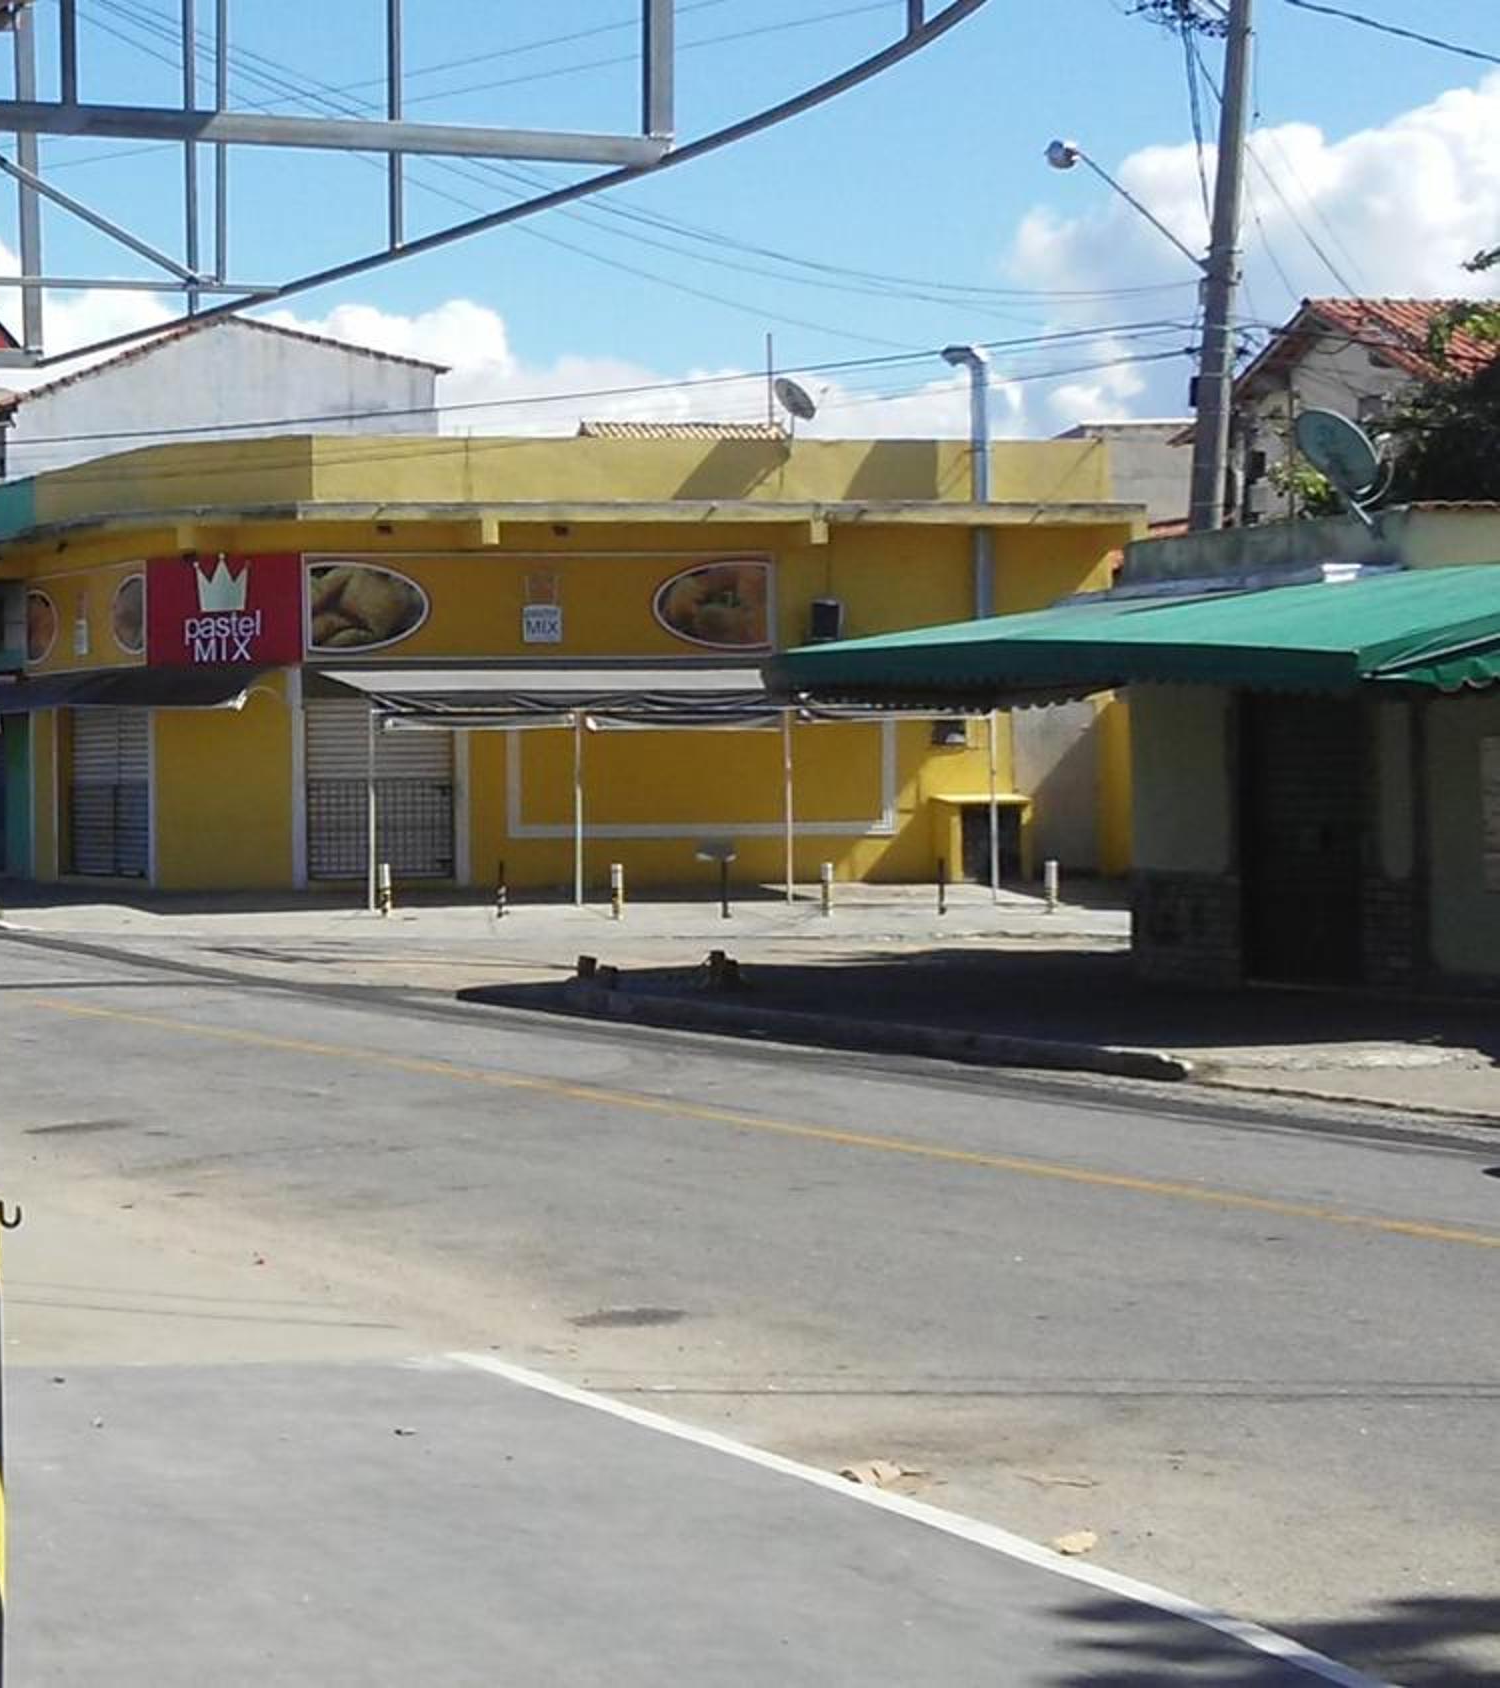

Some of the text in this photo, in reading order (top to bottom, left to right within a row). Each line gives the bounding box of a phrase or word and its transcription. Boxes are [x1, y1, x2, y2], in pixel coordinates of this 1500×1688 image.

[185, 610, 261, 646] pastel
[526, 620, 558, 635] MIX
[195, 637, 252, 662] MIX
